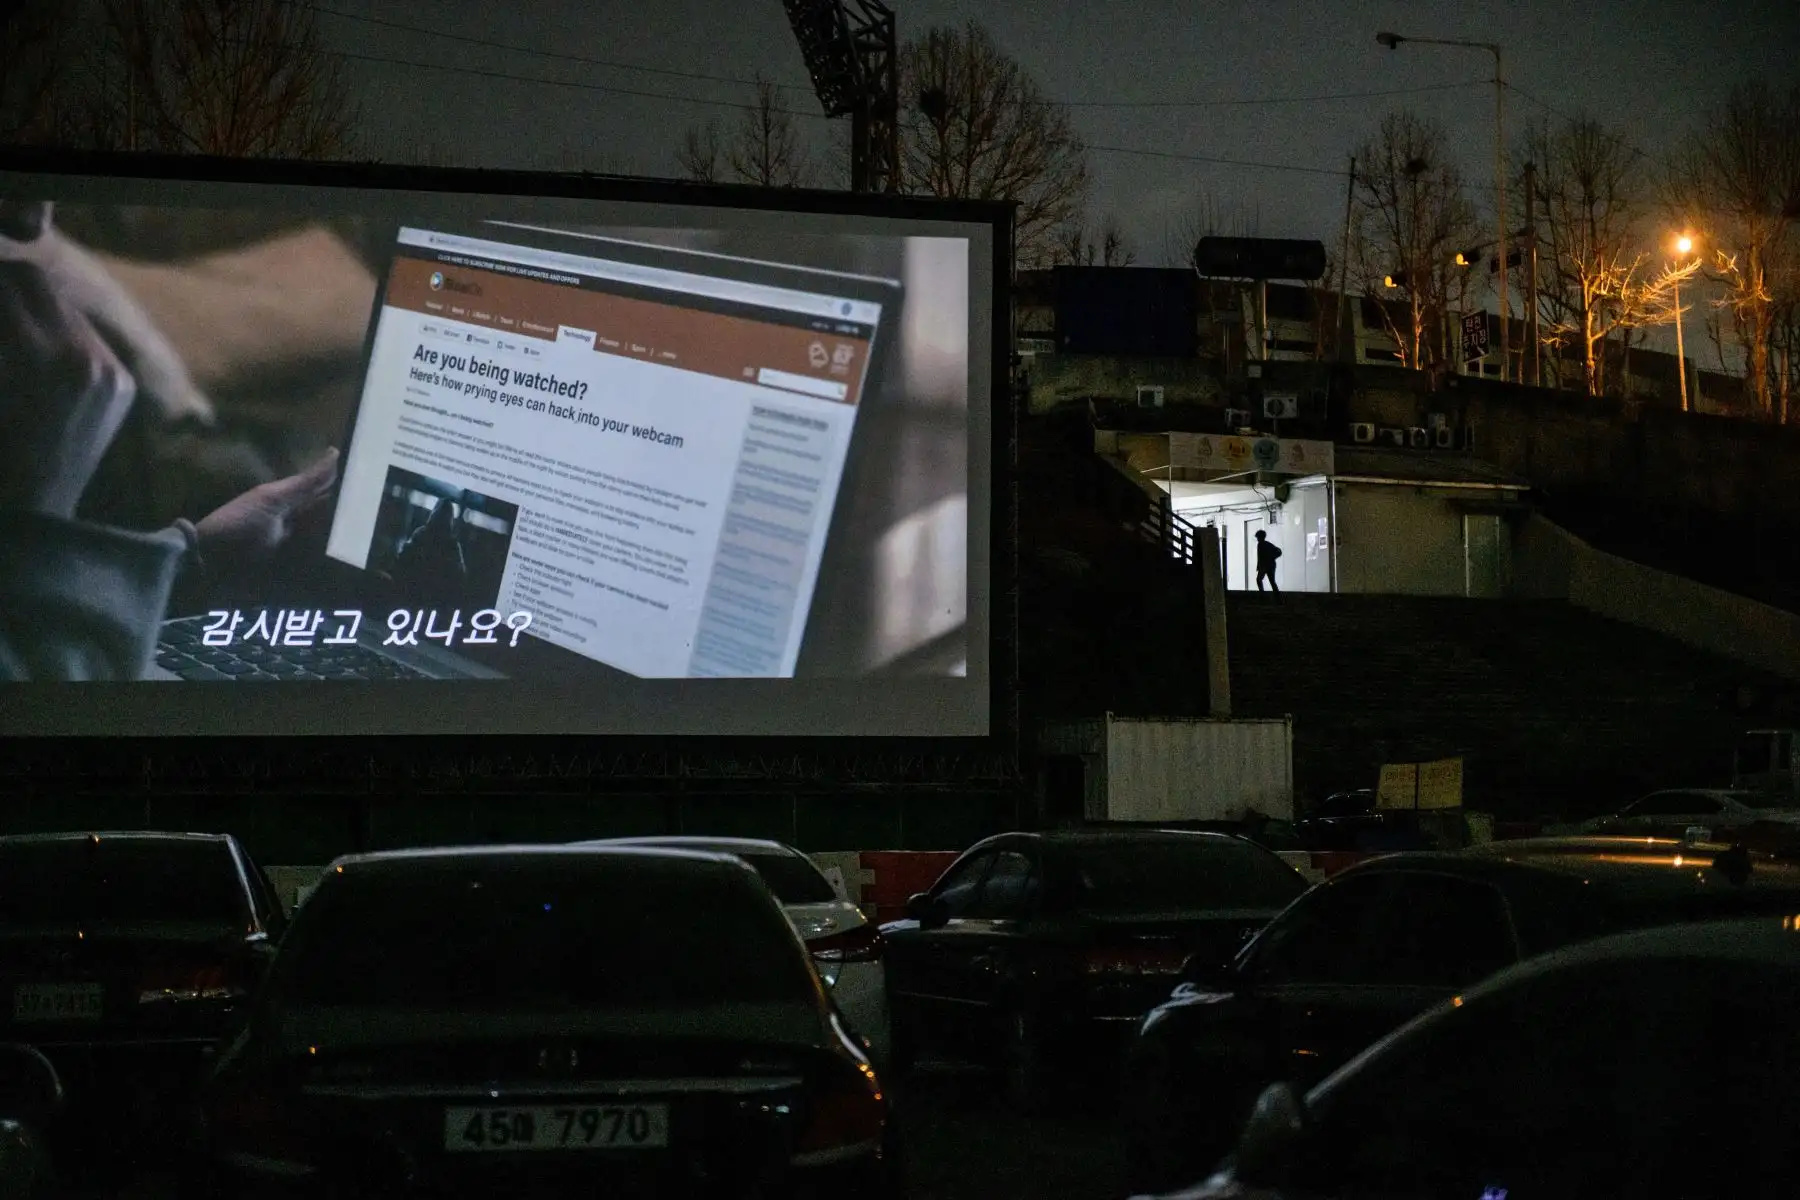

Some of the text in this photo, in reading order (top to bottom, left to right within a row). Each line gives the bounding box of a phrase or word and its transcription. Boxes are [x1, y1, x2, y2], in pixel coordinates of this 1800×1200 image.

[413, 344, 588, 400] Are you being watched?
[410, 367, 684, 448] Here's how prying eyes can hack into your webcam
[202, 608, 363, 647] 감시받고
[382, 608, 533, 648] 있나요?
[554, 1108, 649, 1145] 7970
